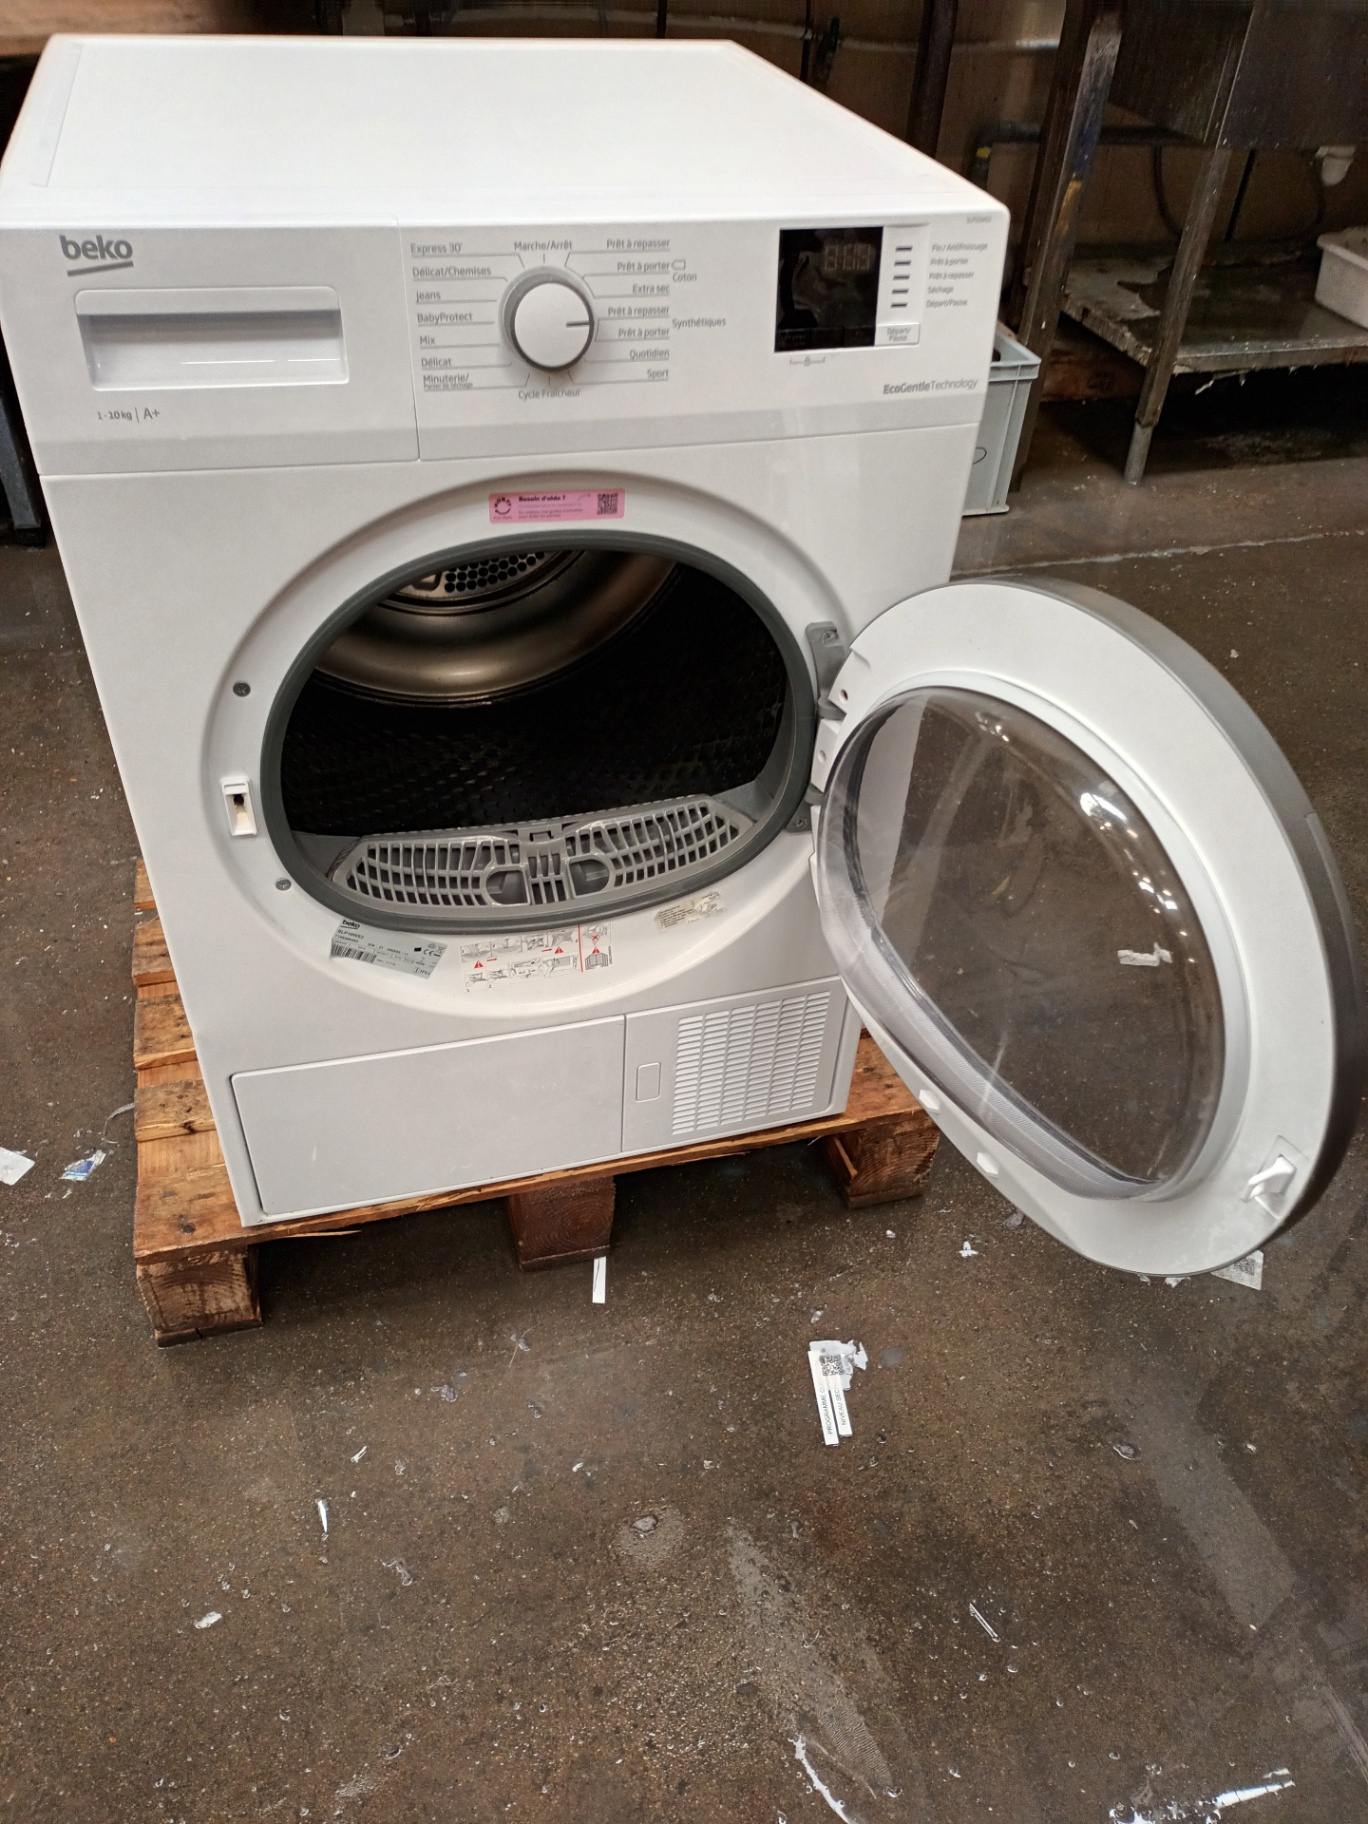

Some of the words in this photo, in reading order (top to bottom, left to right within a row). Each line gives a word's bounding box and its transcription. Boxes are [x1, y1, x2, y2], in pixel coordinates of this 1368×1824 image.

[60, 235, 132, 259] beko
[410, 243, 447, 255] Express
[514, 239, 572, 251] Marche/Arrêt
[606, 238, 624, 249] Prêt
[627, 238, 632, 248] à
[633, 239, 670, 251] repasser
[412, 265, 491, 277] Délicat/Chemises
[617, 261, 635, 271] Prêt
[637, 261, 642, 271] à
[643, 261, 670, 274] porter
[672, 272, 697, 282] Coton
[632, 283, 654, 294] Extra
[656, 284, 669, 294] sec
[416, 290, 441, 302] Jeans
[608, 306, 626, 317] Prêt
[627, 306, 632, 316] à
[634, 306, 670, 317] repasser
[417, 312, 472, 324] BabyProtect
[672, 317, 727, 330] Synthétiques
[618, 328, 636, 338] Prêt
[637, 328, 642, 338] à
[643, 328, 670, 339] porter
[420, 335, 435, 345] Mix
[629, 349, 670, 360] Quotidien
[421, 357, 451, 367] Délicat
[423, 372, 469, 384] Minuterie/
[646, 368, 669, 379] Sport
[518, 389, 540, 401] Cycle
[541, 389, 580, 399] Fraîcheur
[143, 407, 160, 419] A+
[820, 1394, 834, 1434] PROGRAMME
